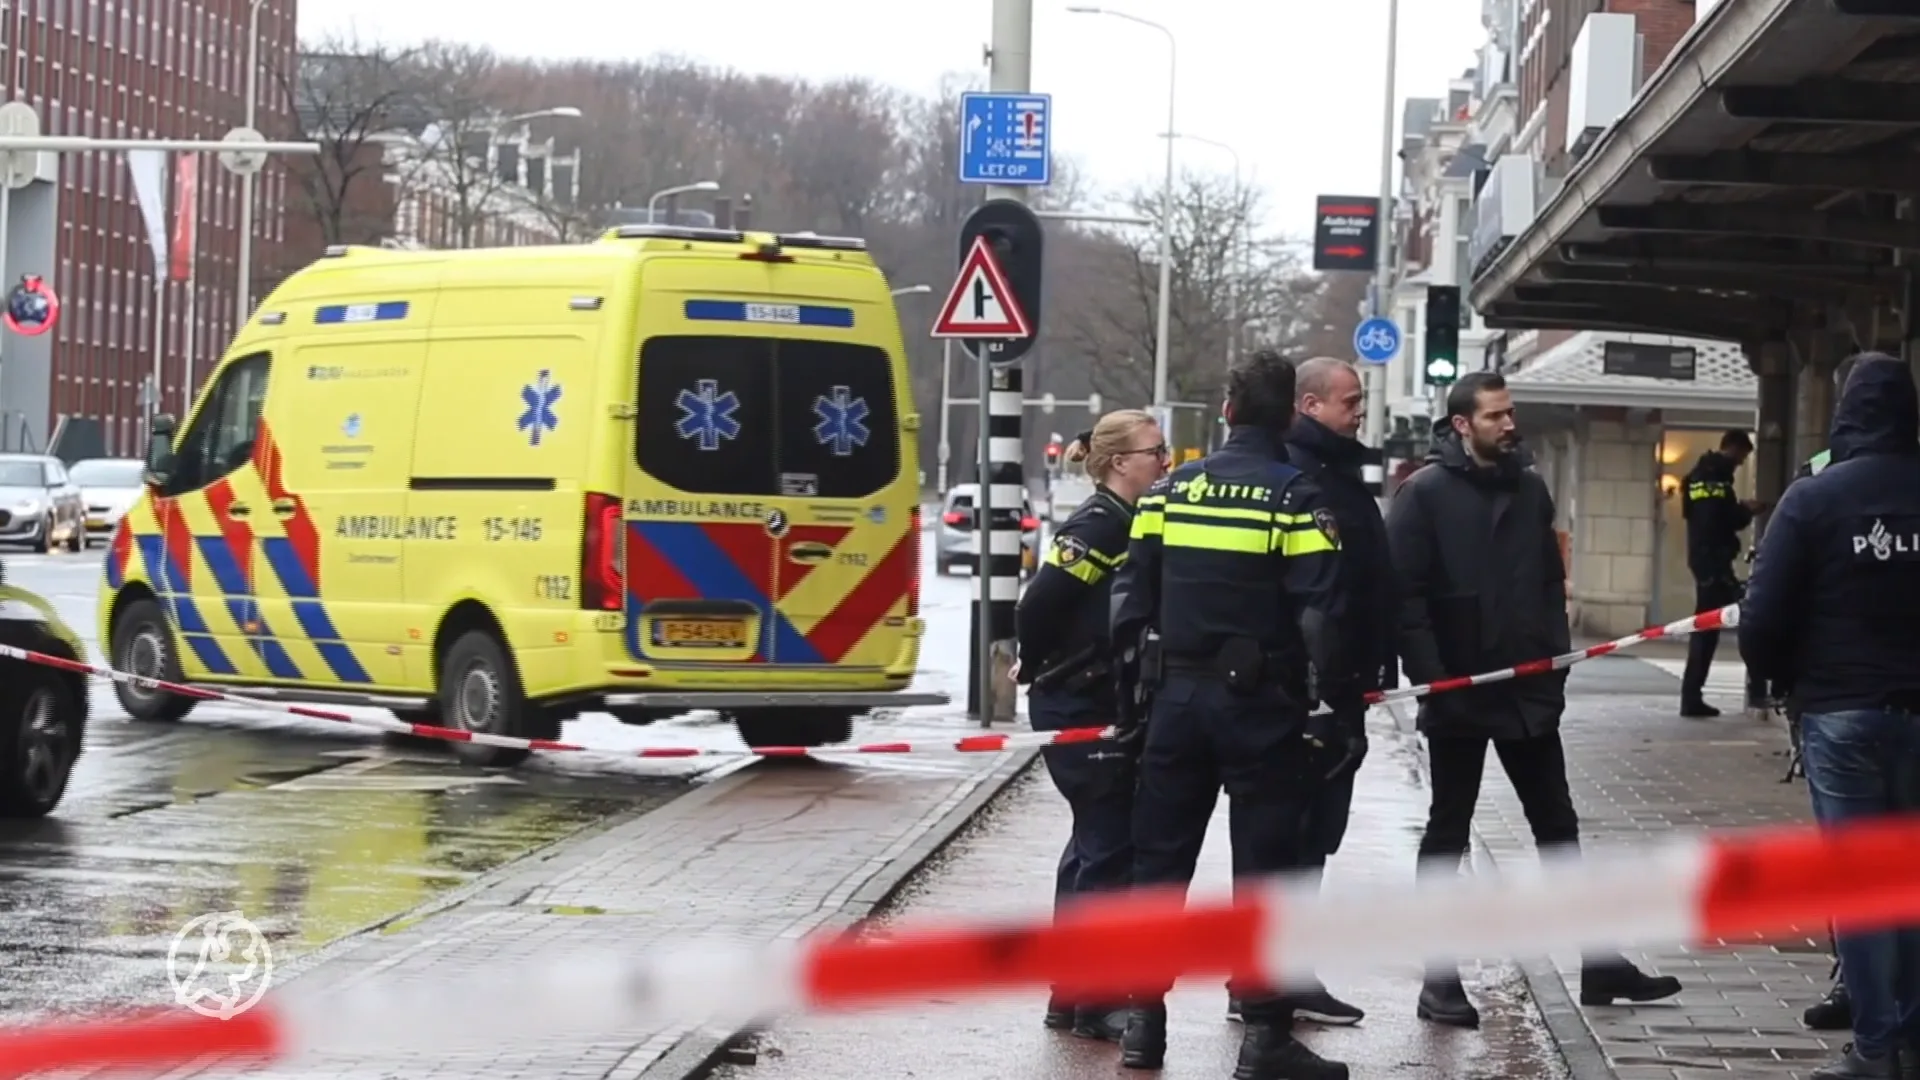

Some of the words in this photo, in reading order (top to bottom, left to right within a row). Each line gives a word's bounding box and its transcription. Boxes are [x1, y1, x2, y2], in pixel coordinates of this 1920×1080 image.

[979, 164, 1005, 176] LET
[1007, 164, 1028, 176] OP
[1177, 473, 1266, 503] POLITIE
[628, 499, 765, 519] AMBULANCE
[336, 515, 457, 539] AMBULANCE
[482, 516, 543, 541] 15-146
